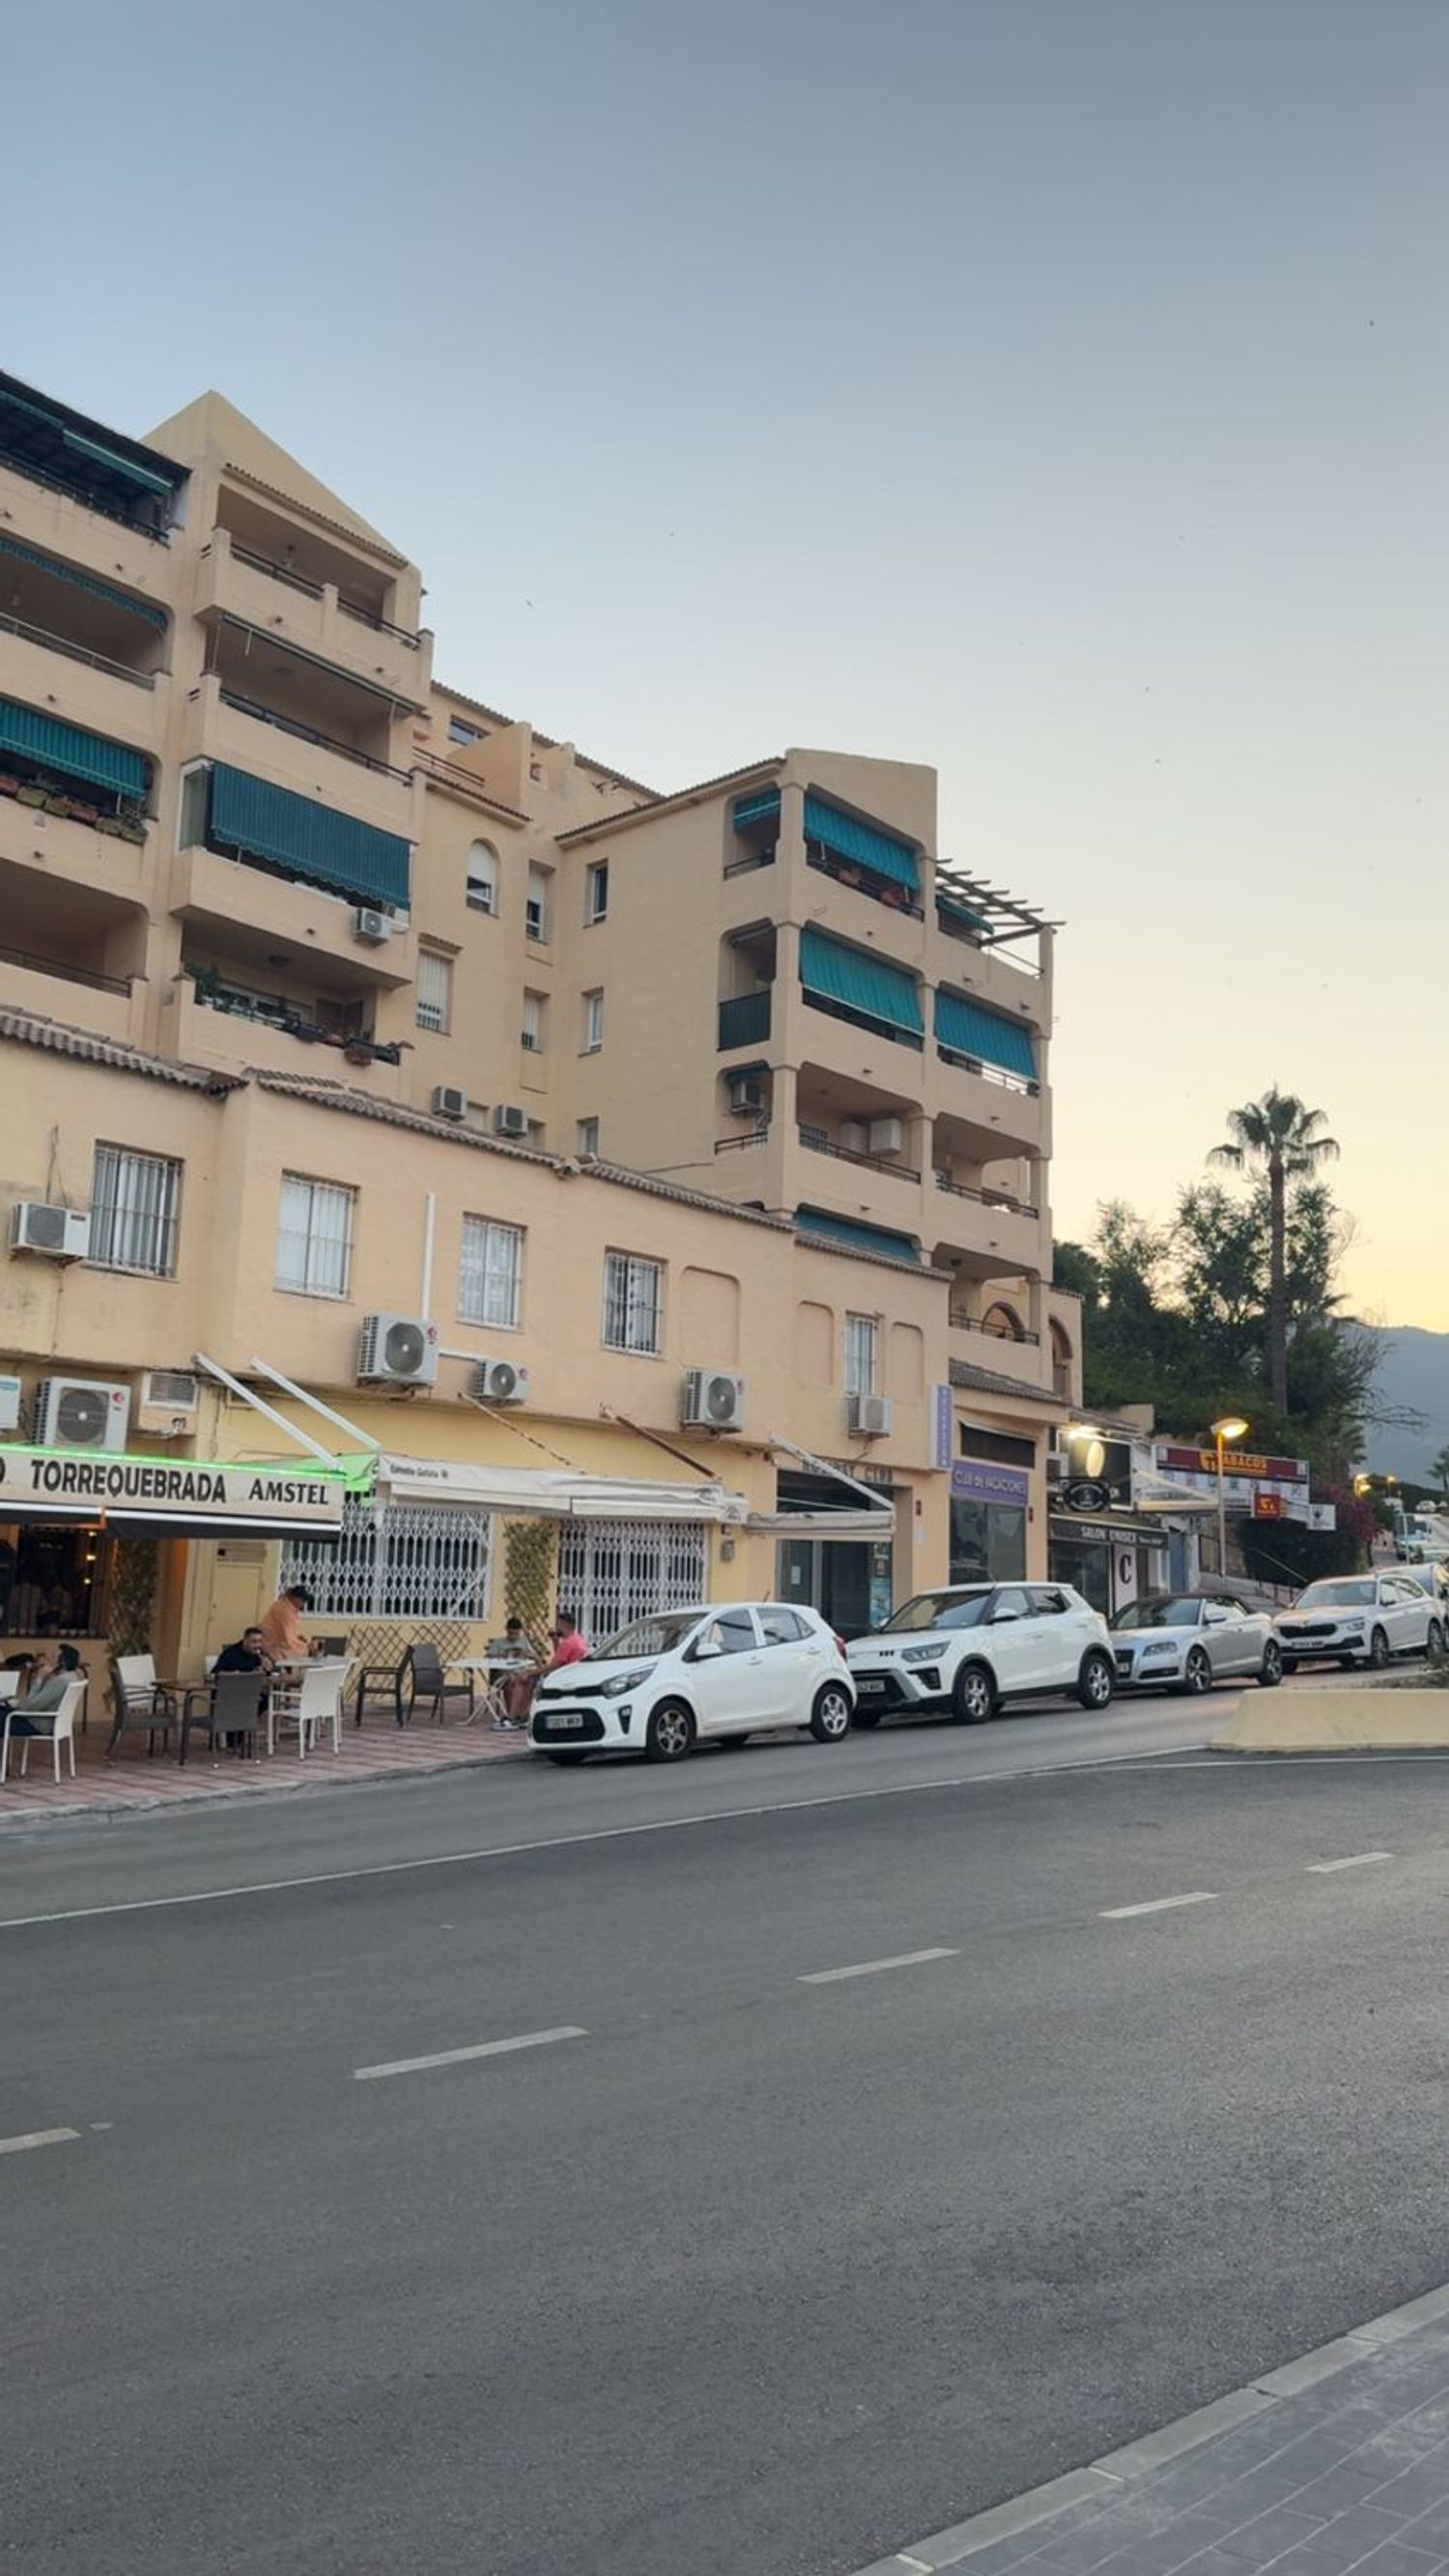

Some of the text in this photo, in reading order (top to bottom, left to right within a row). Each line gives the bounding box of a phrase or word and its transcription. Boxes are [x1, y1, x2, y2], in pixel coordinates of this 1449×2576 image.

[1217, 1452, 1267, 1470] ABACOS
[31, 1459, 226, 1503] TORREQUEBRADA
[248, 1478, 329, 1505] AMSTEL
[1120, 1555, 1131, 1585] C
